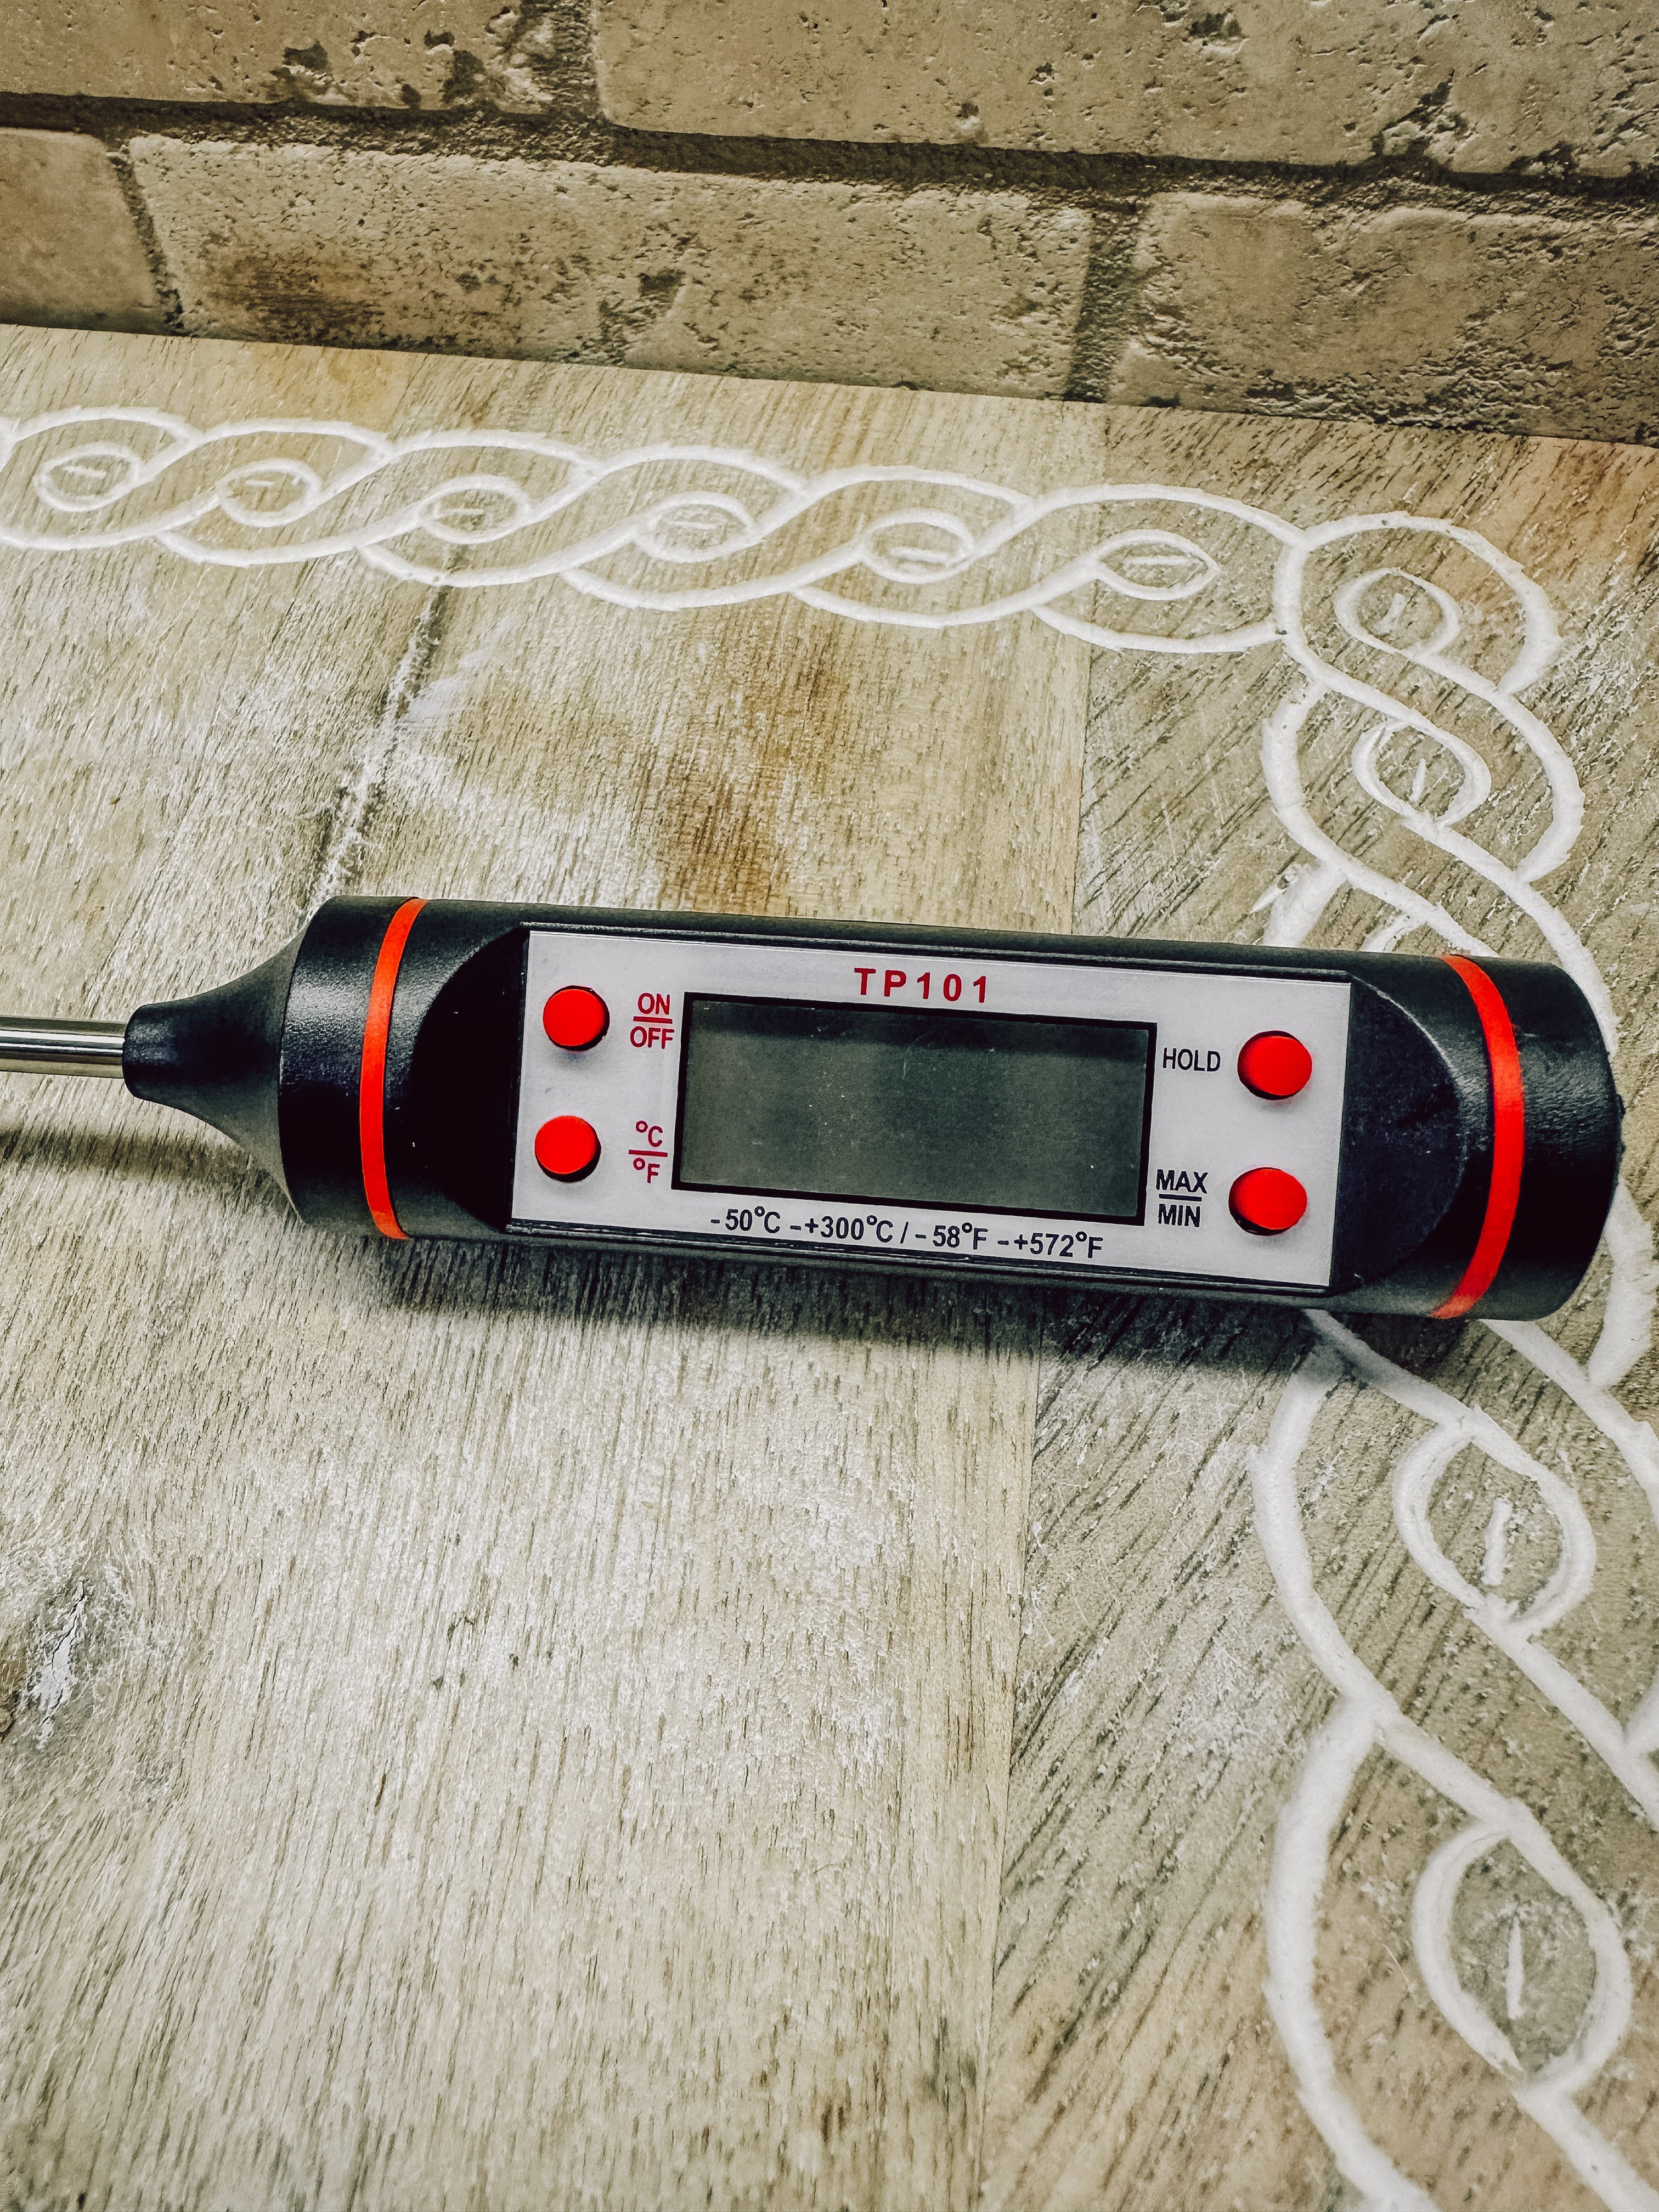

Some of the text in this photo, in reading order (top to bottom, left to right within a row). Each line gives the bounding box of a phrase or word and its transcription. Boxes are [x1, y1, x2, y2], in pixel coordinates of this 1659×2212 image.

[854, 967, 986, 1003] TP101
[637, 992, 670, 1015] ON
[630, 1026, 675, 1049] OFF
[1162, 1047, 1221, 1072] HOLD
[635, 1120, 663, 1148] °C
[633, 1157, 661, 1184] °F
[1155, 1169, 1209, 1194] MAX
[1158, 1203, 1201, 1228] MIN
